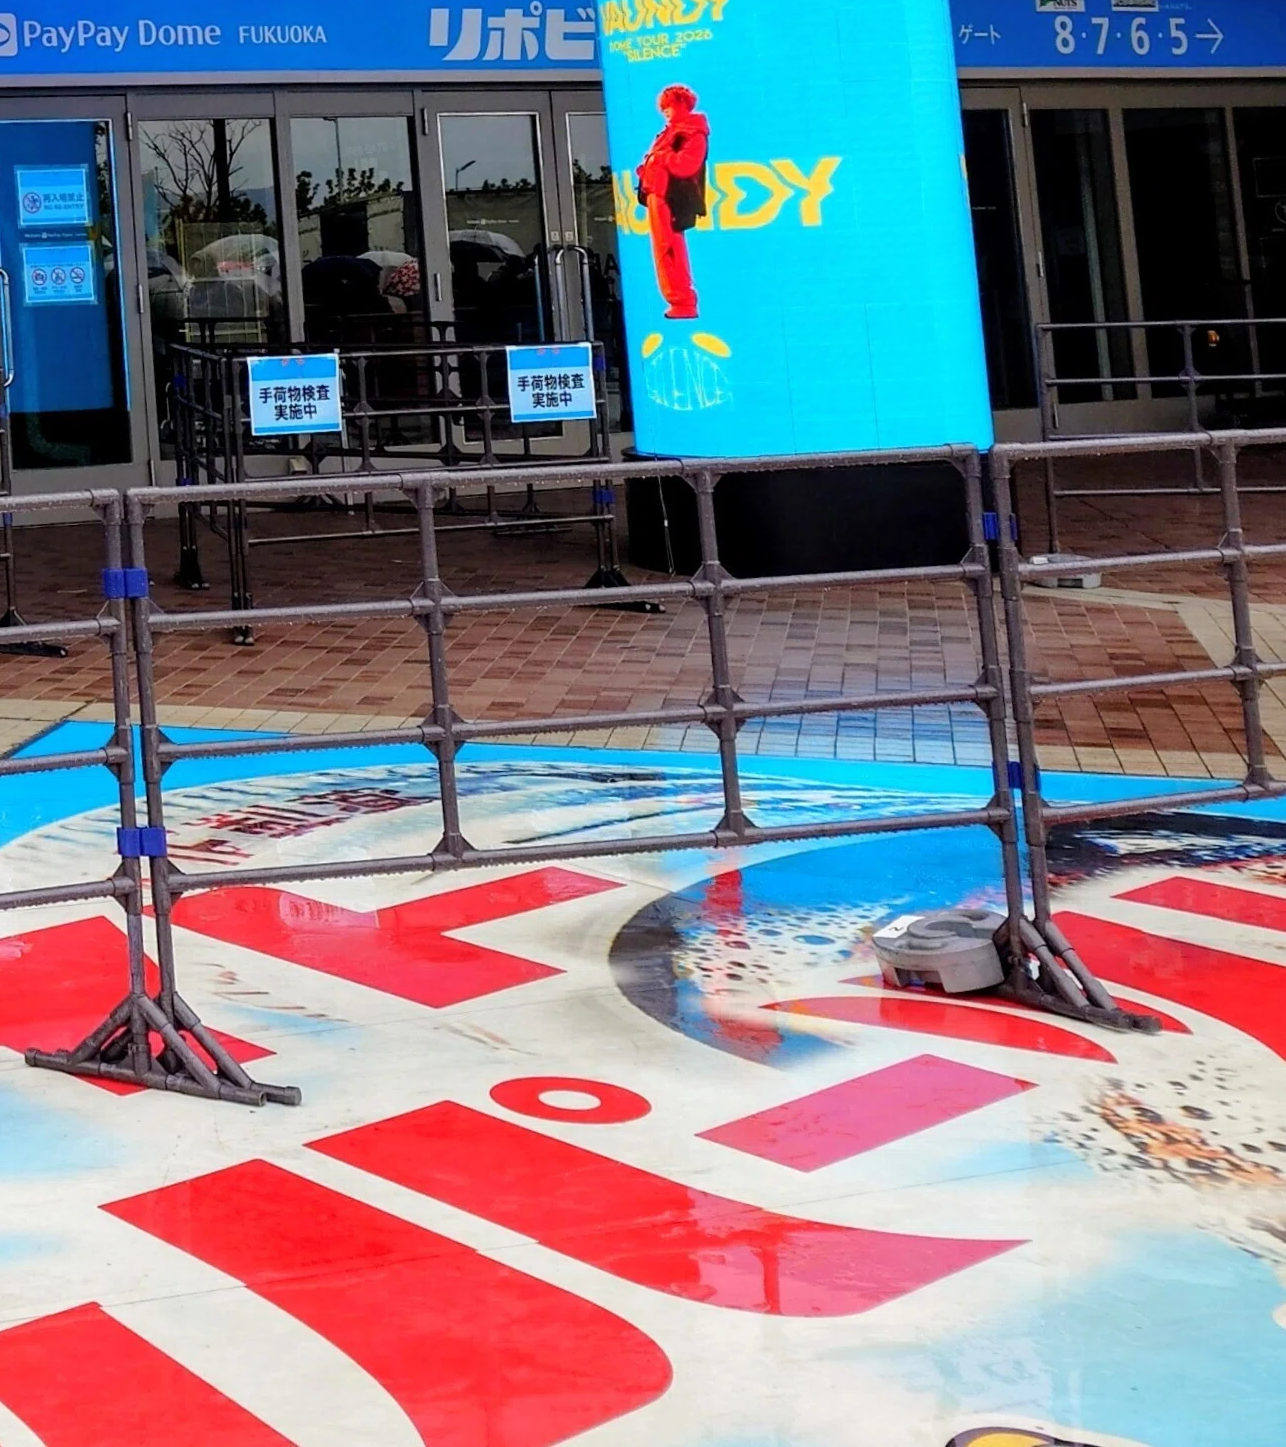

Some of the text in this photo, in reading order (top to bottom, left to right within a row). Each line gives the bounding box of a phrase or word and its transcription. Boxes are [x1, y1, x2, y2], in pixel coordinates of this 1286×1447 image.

[23, 20, 129, 52] PayPay
[138, 19, 222, 46] Dome
[239, 24, 327, 45] FUKUOKA
[958, 24, 1001, 45] ゲート
[517, 374, 585, 392] 手荷物検査
[259, 385, 330, 404] 手荷物検査
[532, 391, 572, 408] 実施中
[274, 403, 317, 421] 実施中
